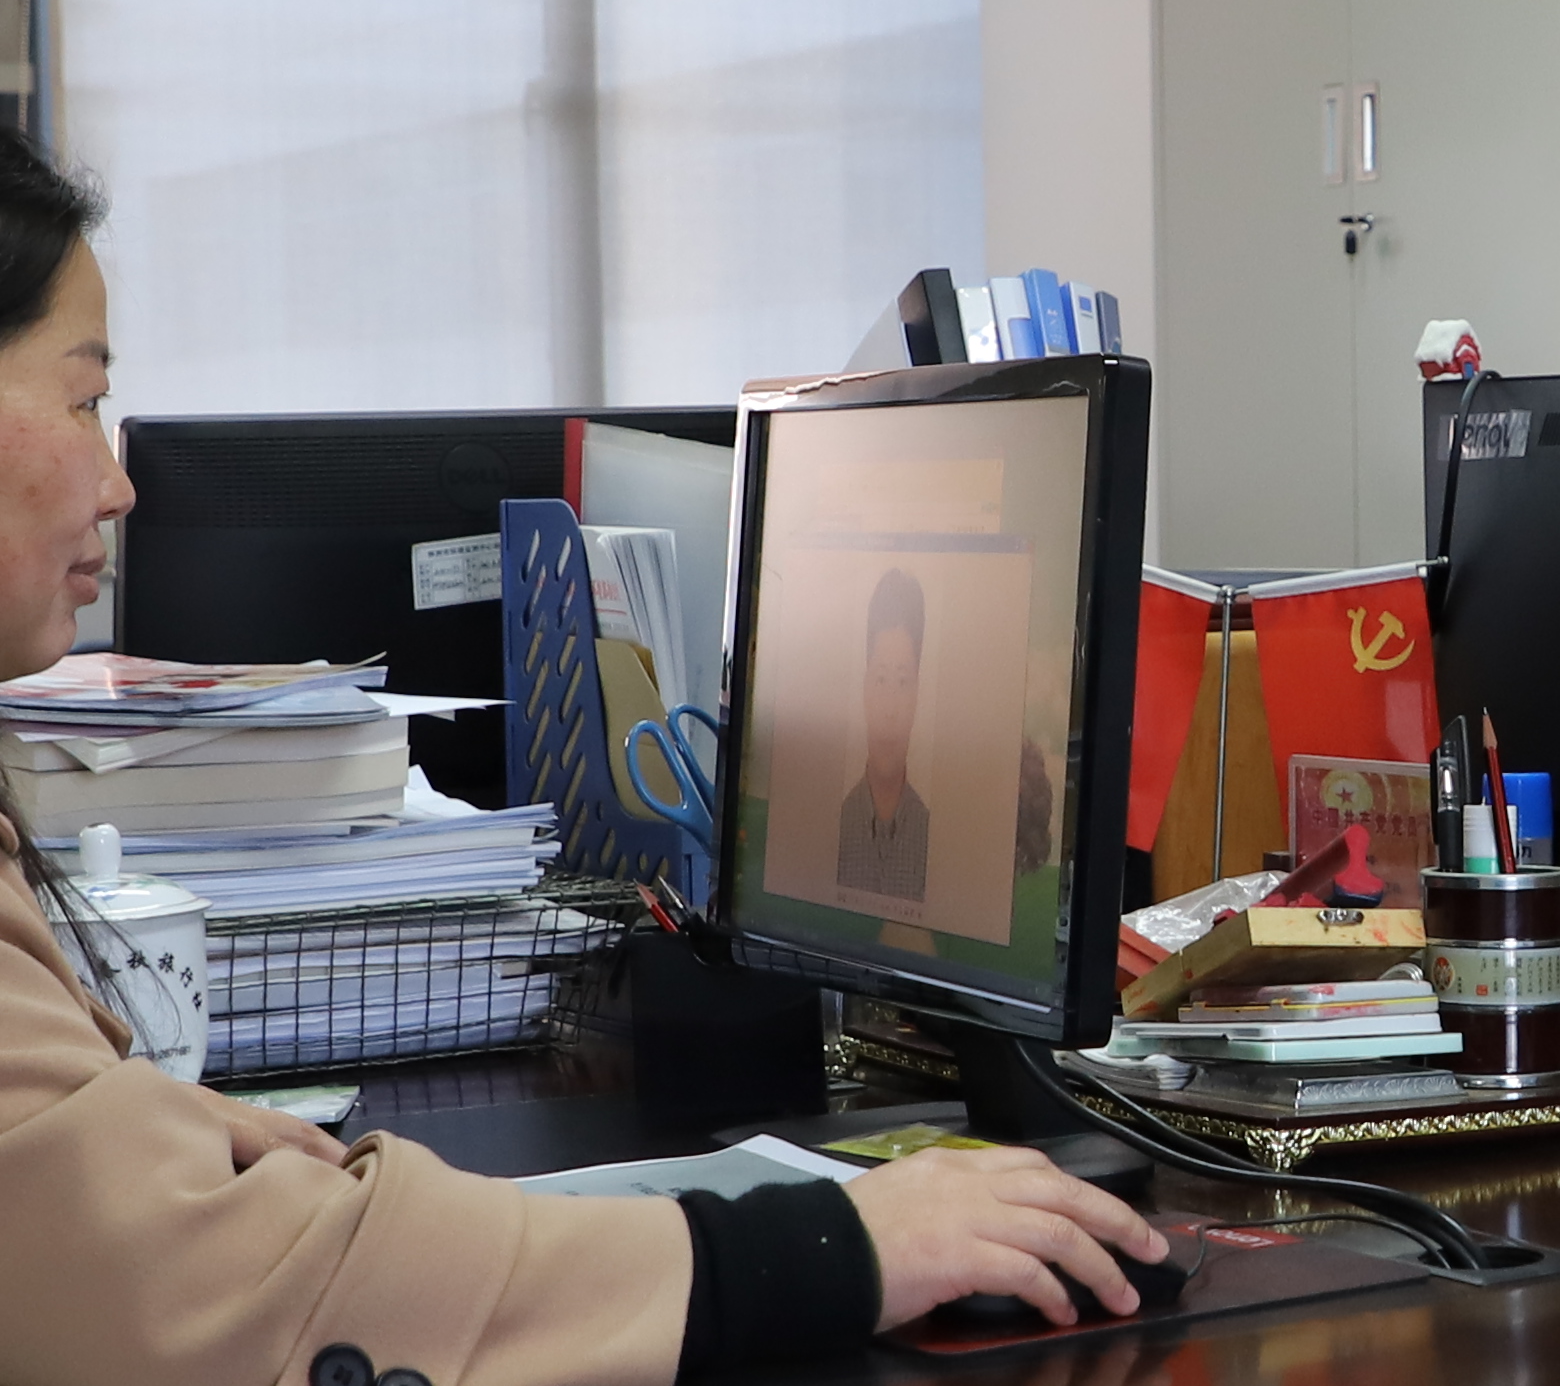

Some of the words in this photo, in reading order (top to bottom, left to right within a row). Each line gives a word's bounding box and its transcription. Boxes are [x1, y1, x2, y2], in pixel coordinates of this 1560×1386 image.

[1313, 808, 1431, 837] 中国共产党党员
